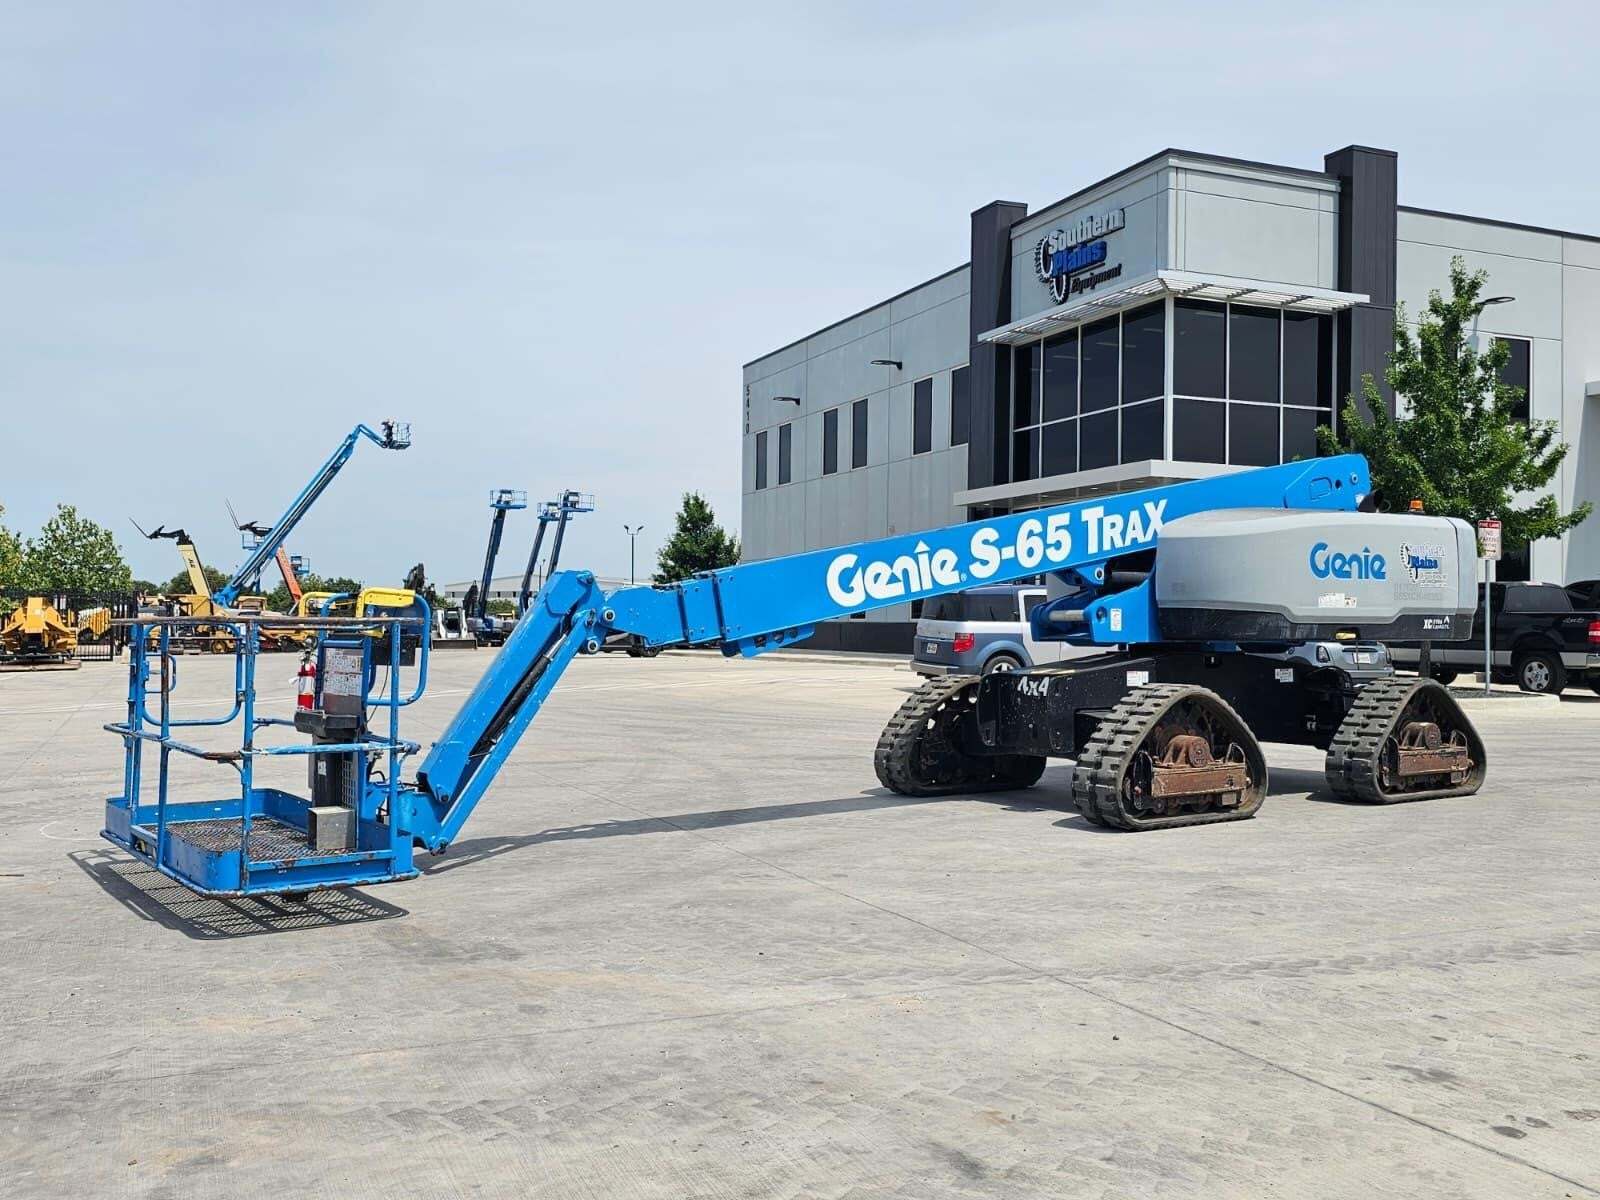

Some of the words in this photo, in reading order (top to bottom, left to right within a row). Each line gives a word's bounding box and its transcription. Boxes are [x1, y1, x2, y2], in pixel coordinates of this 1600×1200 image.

[1048, 207, 1125, 255] Southern
[1052, 241, 1107, 277] Plains
[1070, 263, 1122, 294] Equipment
[826, 540, 961, 607] Genie
[969, 512, 1072, 579] S-65
[1309, 541, 1386, 580] Genie
[1017, 676, 1051, 697] 4x4
